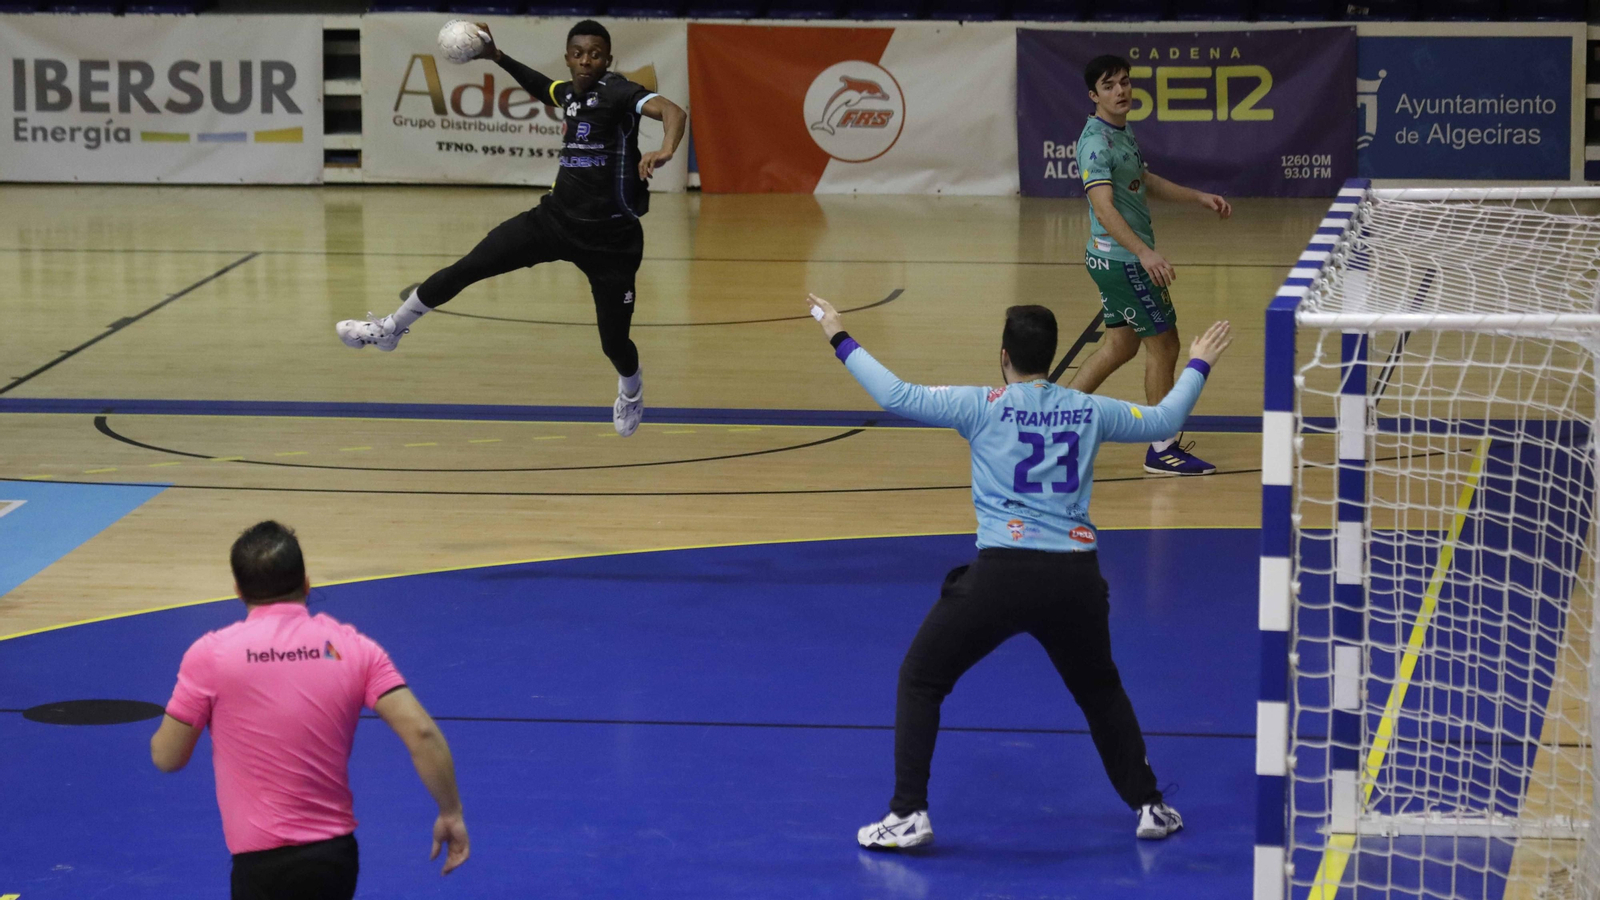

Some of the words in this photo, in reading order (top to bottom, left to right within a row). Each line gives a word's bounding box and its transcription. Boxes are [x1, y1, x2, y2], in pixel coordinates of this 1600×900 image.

[1129, 47, 1241, 59] CADENA
[12, 58, 303, 114] IBERSUR
[1395, 93, 1557, 119] Ayuntamiento
[13, 117, 131, 150] Energía
[393, 115, 436, 132] Grupo
[440, 118, 524, 133] Distribuidor
[1395, 127, 1418, 144] de
[1426, 122, 1541, 149] Algeciras
[1281, 154, 1310, 167] 1260
[1312, 154, 1331, 166] OM
[1284, 167, 1311, 179] 93.0
[1313, 167, 1332, 178] FM
[1013, 431, 1080, 493] 23
[246, 646, 320, 663] helvetia
